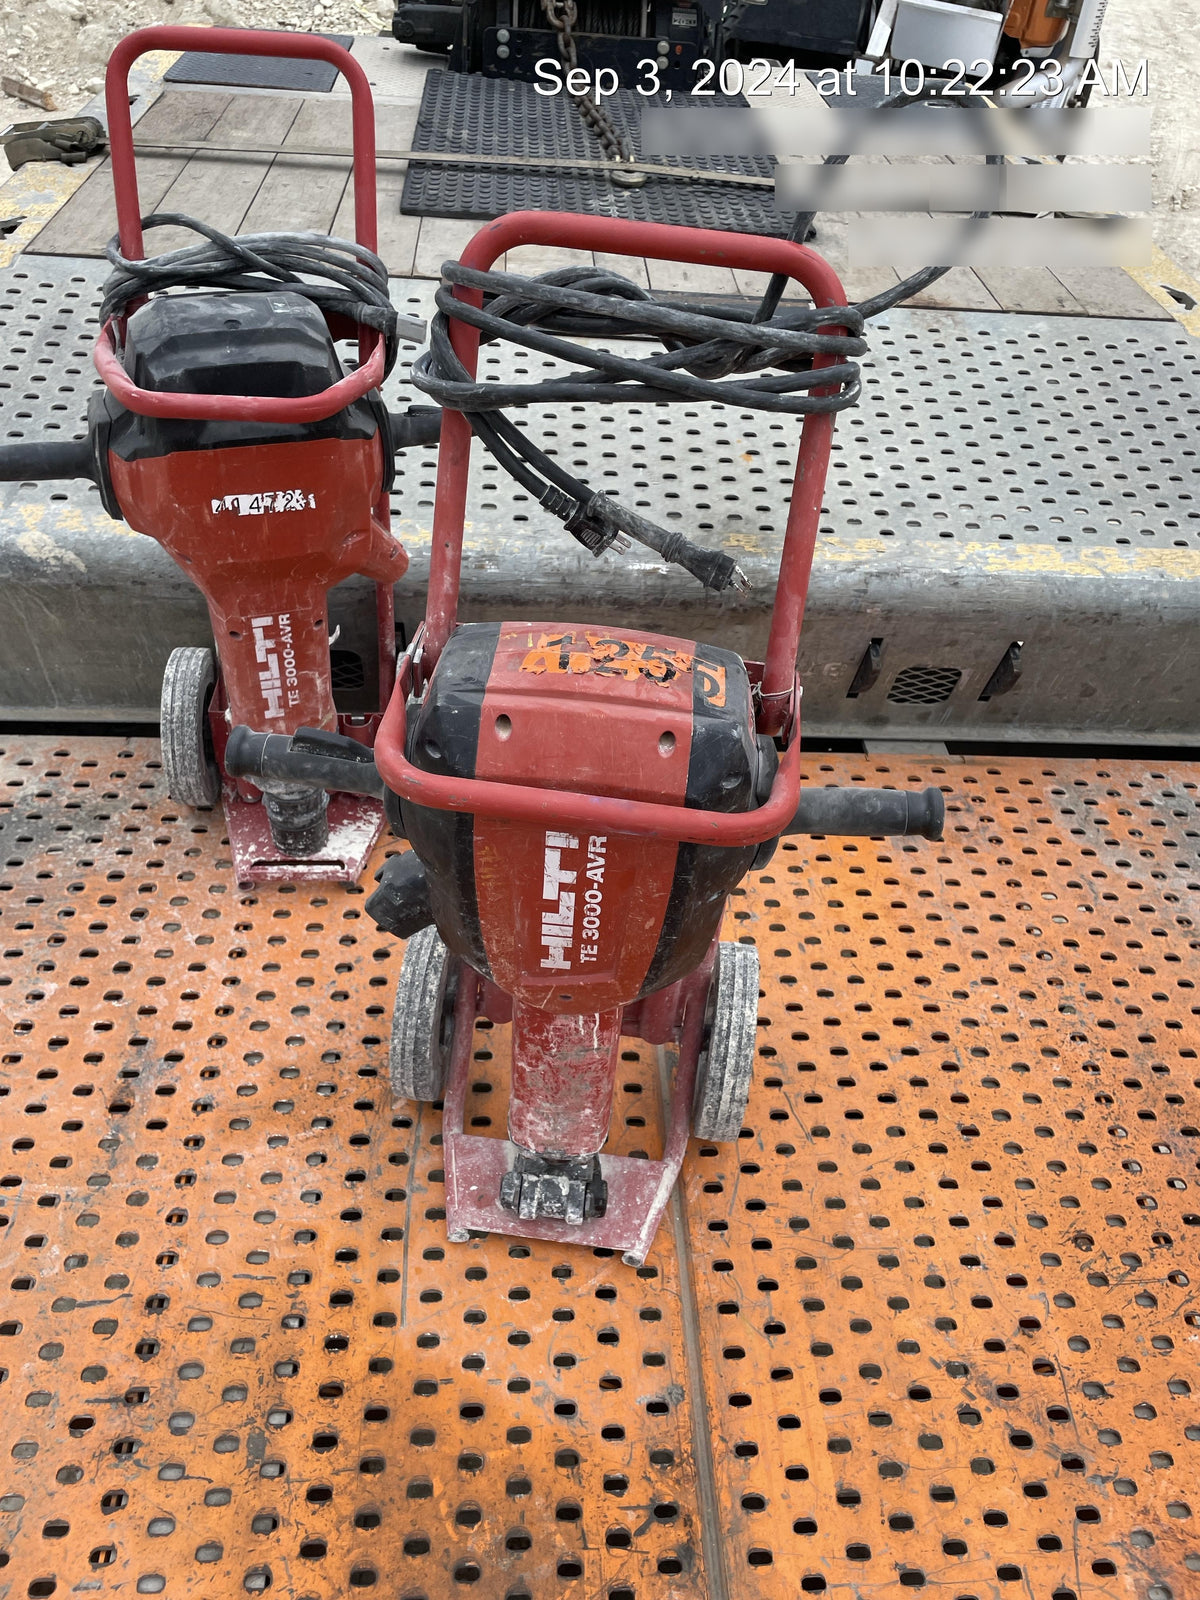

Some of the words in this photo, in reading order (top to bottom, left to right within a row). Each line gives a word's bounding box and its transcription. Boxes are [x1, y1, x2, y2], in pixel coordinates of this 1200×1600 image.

[251, 616, 285, 719] HILTI
[278, 613, 298, 687] 3000-AVR
[288, 689, 301, 707] TE
[540, 830, 580, 969] HILTI
[581, 835, 608, 940] 3000-AVR
[580, 944, 598, 963] TE
